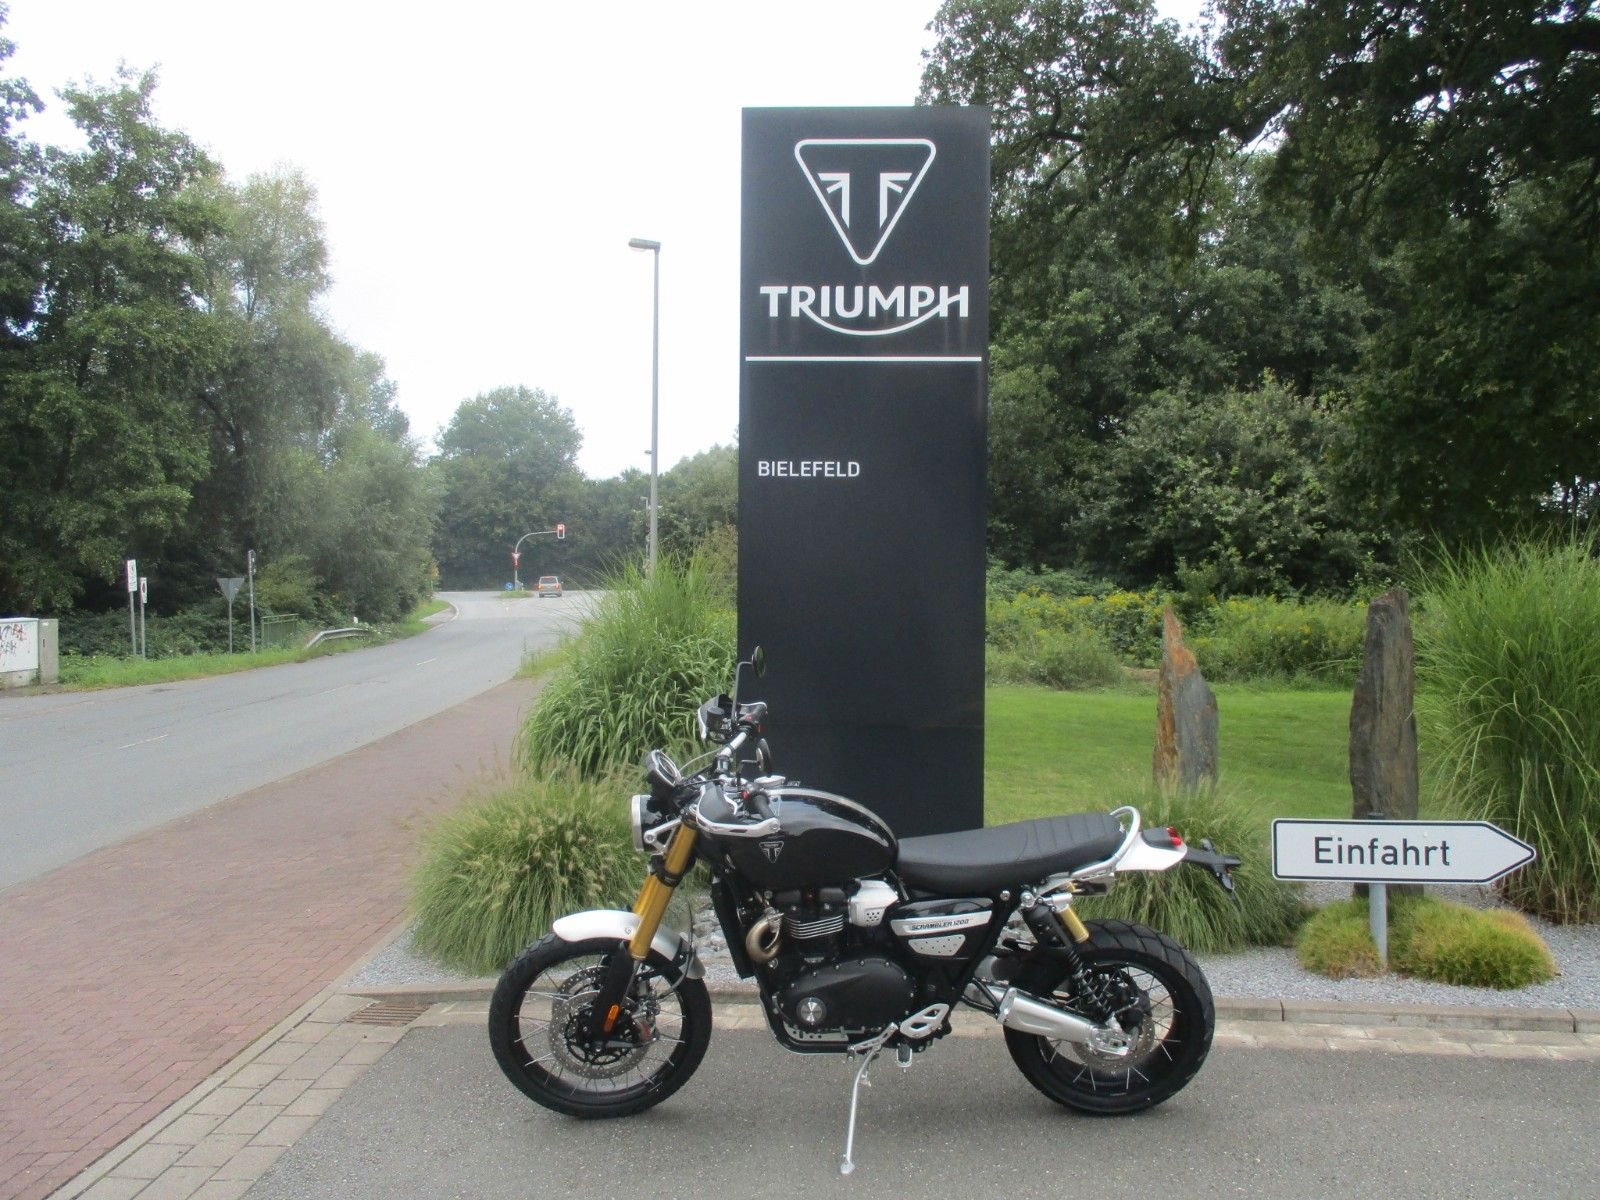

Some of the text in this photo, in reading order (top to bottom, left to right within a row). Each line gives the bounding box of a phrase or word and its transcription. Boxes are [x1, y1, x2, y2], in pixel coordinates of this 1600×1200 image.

[760, 285, 969, 336] TRIUMPH
[758, 460, 860, 477] BIELEFELD
[1314, 836, 1450, 866] Einfahrt
[911, 921, 952, 930] SCRAMBLER
